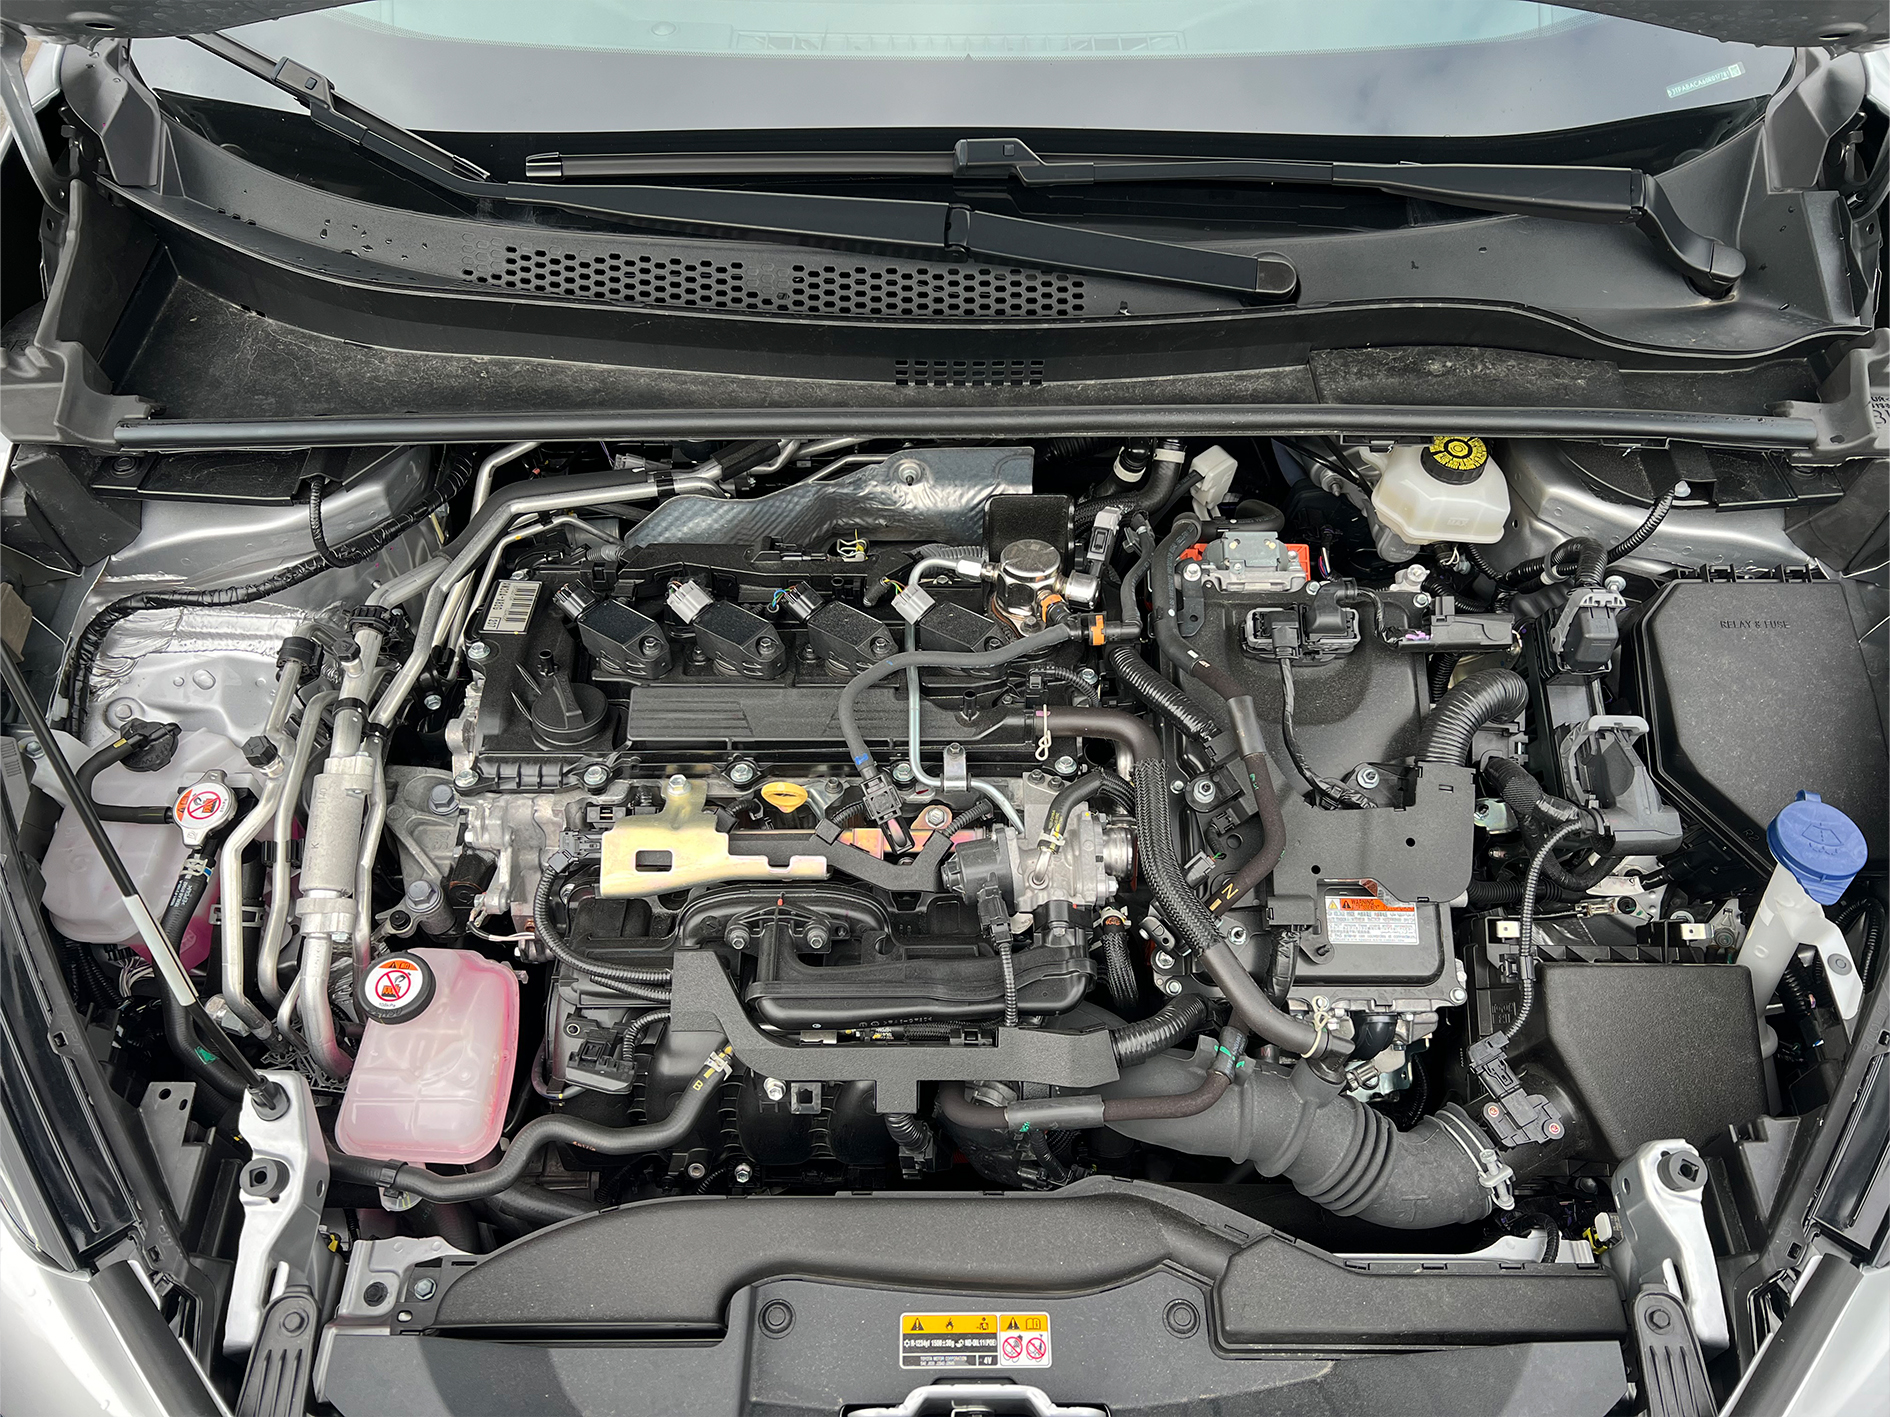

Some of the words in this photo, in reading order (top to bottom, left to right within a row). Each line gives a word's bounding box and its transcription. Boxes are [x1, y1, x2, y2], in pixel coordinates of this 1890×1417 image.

[1720, 620, 1751, 629] RELAY
[1754, 620, 1761, 629] &
[1763, 620, 1790, 629] FUSE
